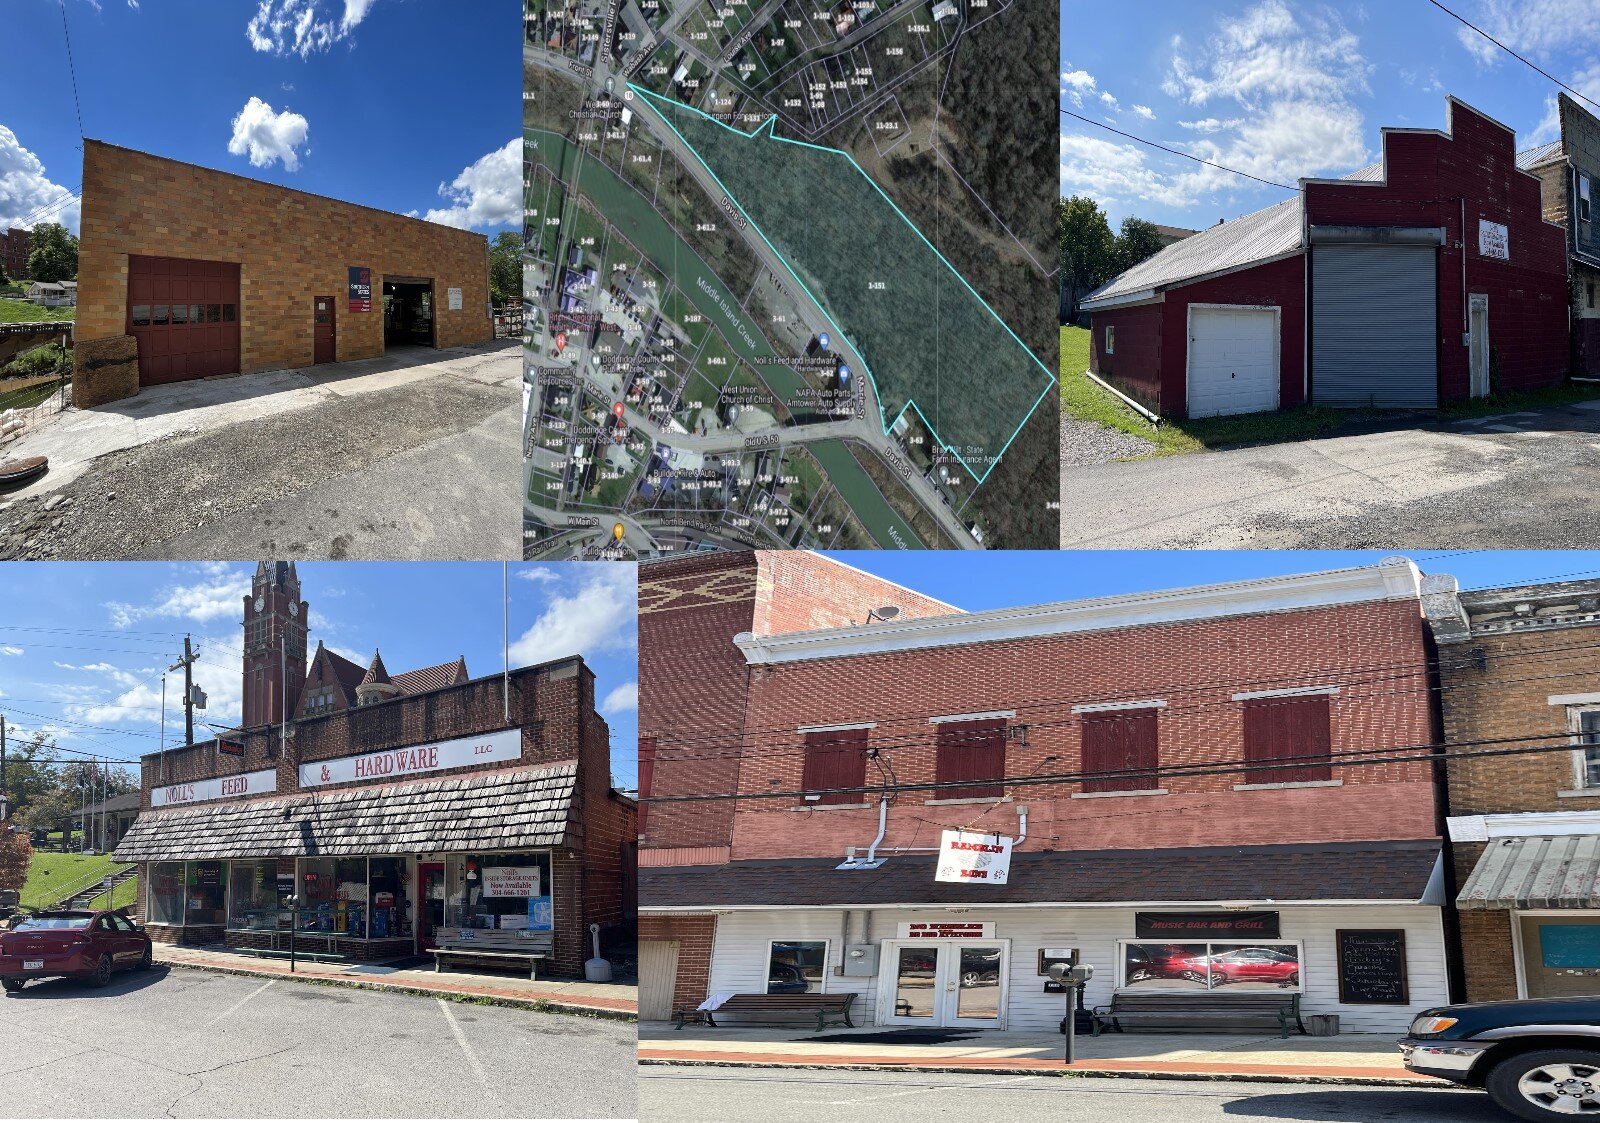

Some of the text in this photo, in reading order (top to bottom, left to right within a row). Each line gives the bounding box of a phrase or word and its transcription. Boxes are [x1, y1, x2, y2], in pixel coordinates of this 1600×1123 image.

[165, 744, 493, 804] NOLL'S FEED & HARDWARE LLC
[1151, 921, 1264, 929] MUSIC BAR AND GRILL
